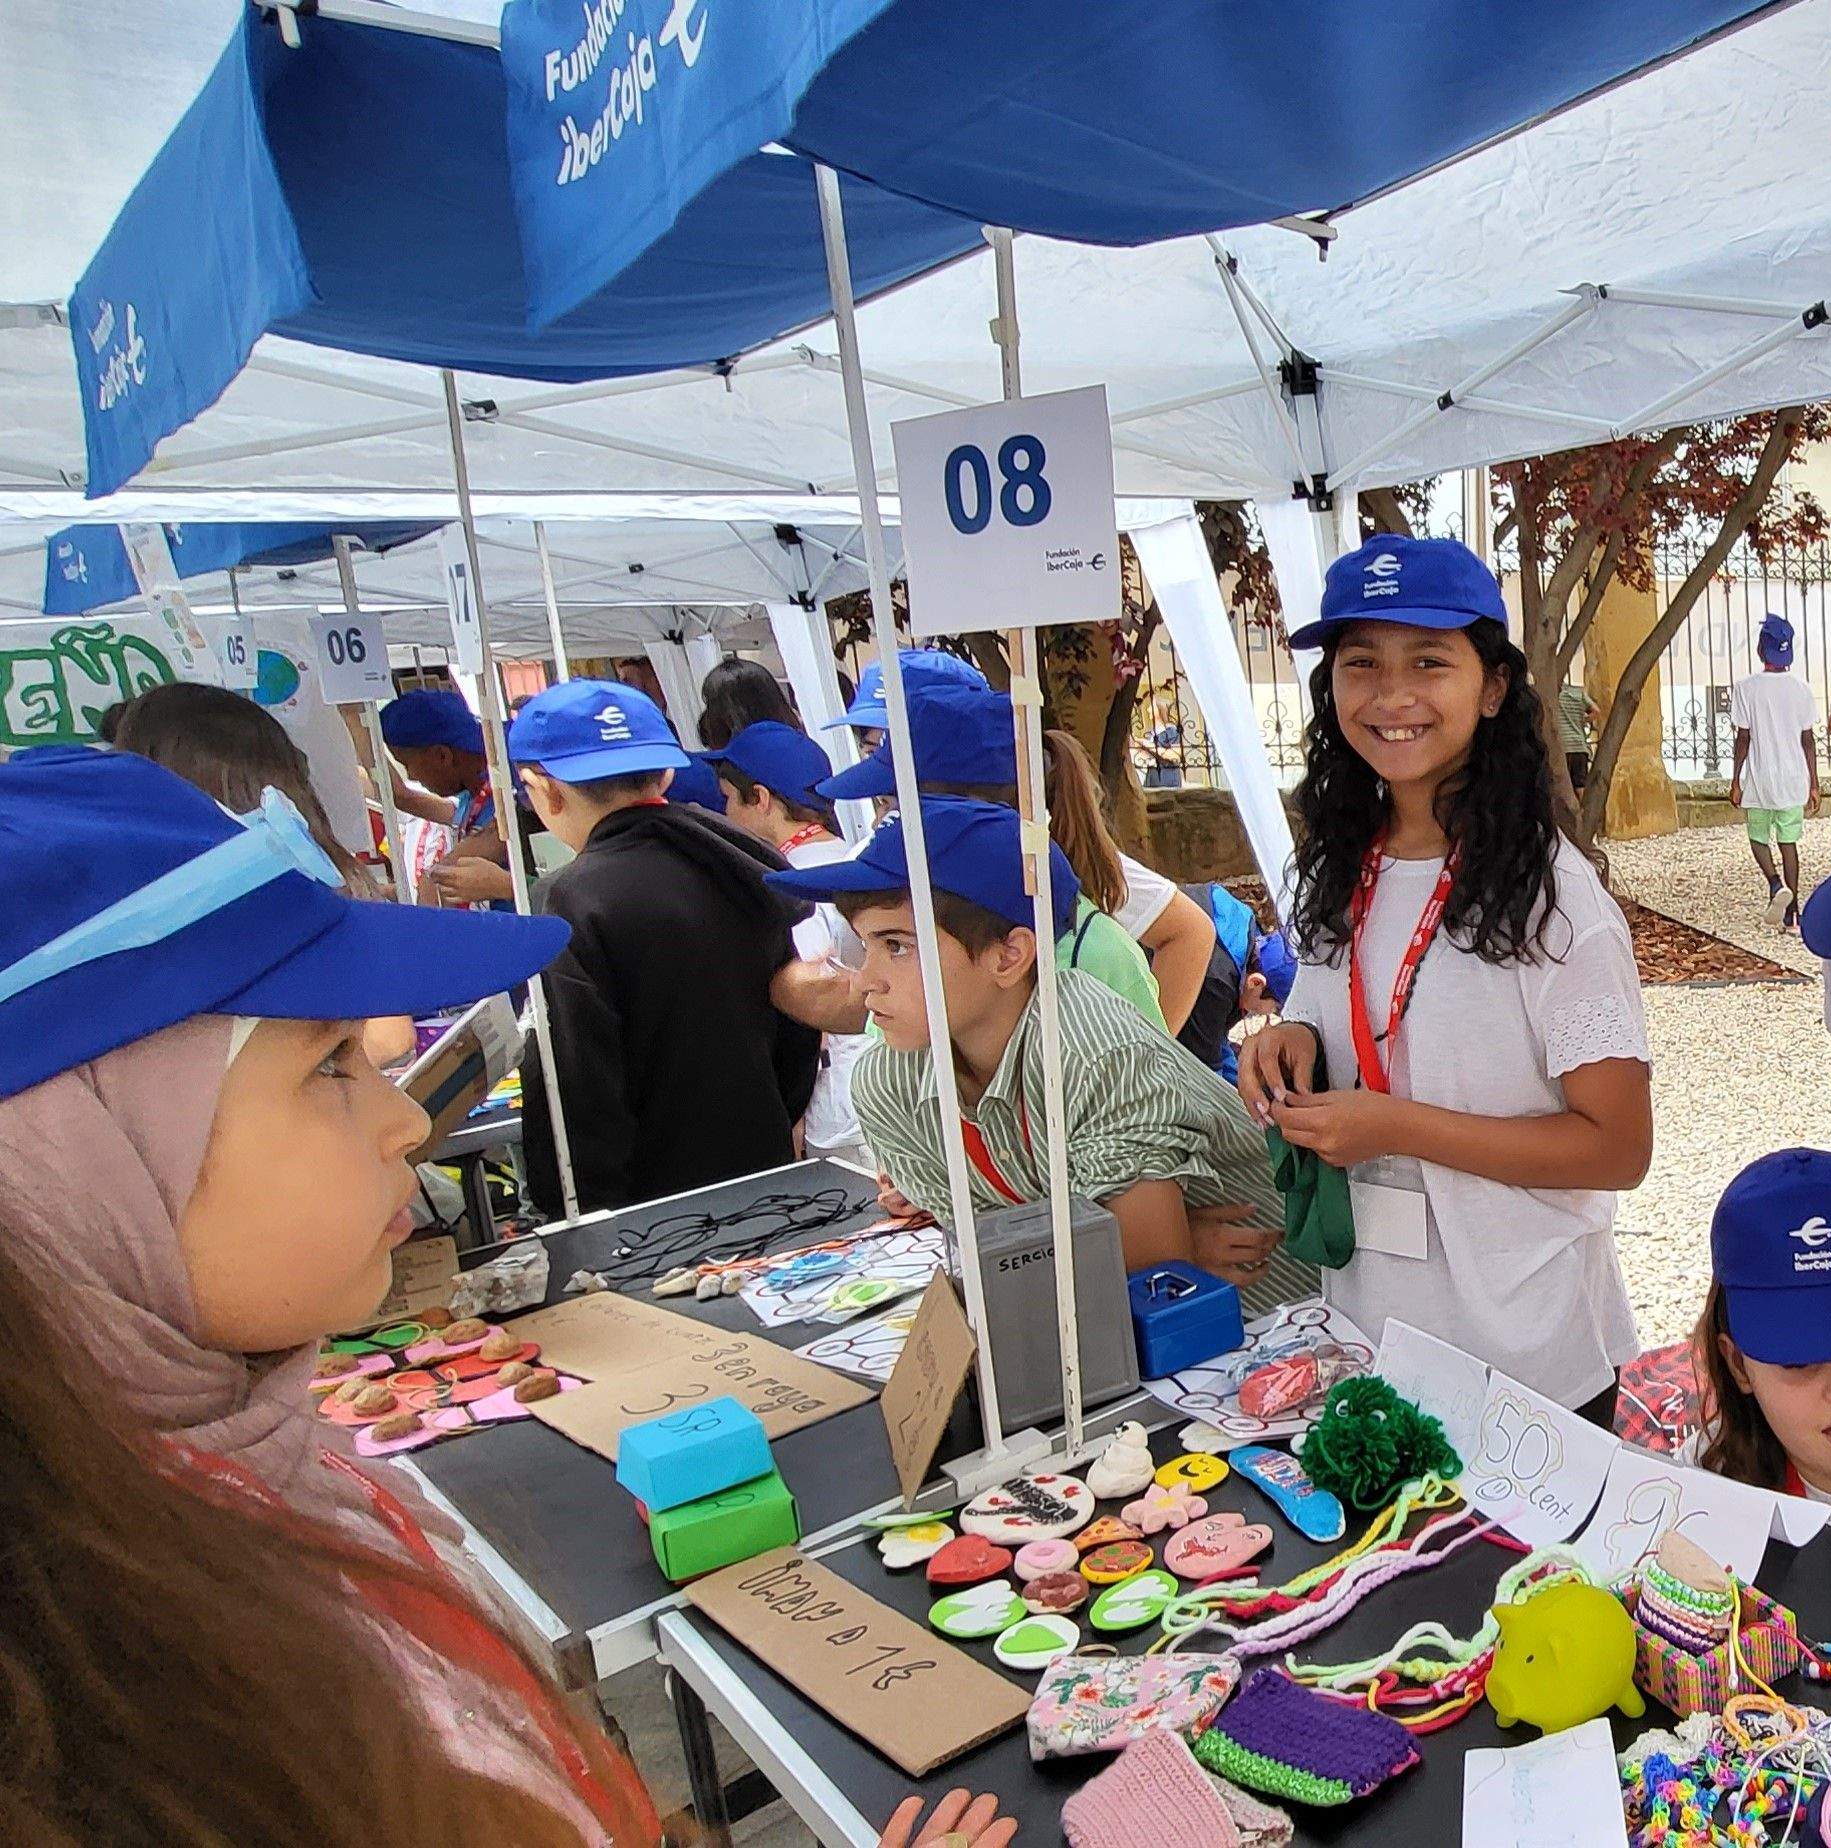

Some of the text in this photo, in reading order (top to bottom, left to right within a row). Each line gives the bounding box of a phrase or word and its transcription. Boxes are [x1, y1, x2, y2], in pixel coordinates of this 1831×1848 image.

[944, 434, 1052, 535] 08
[226, 634, 246, 666] 05
[328, 627, 367, 666] 06
[1485, 1402, 1550, 1481] 50
